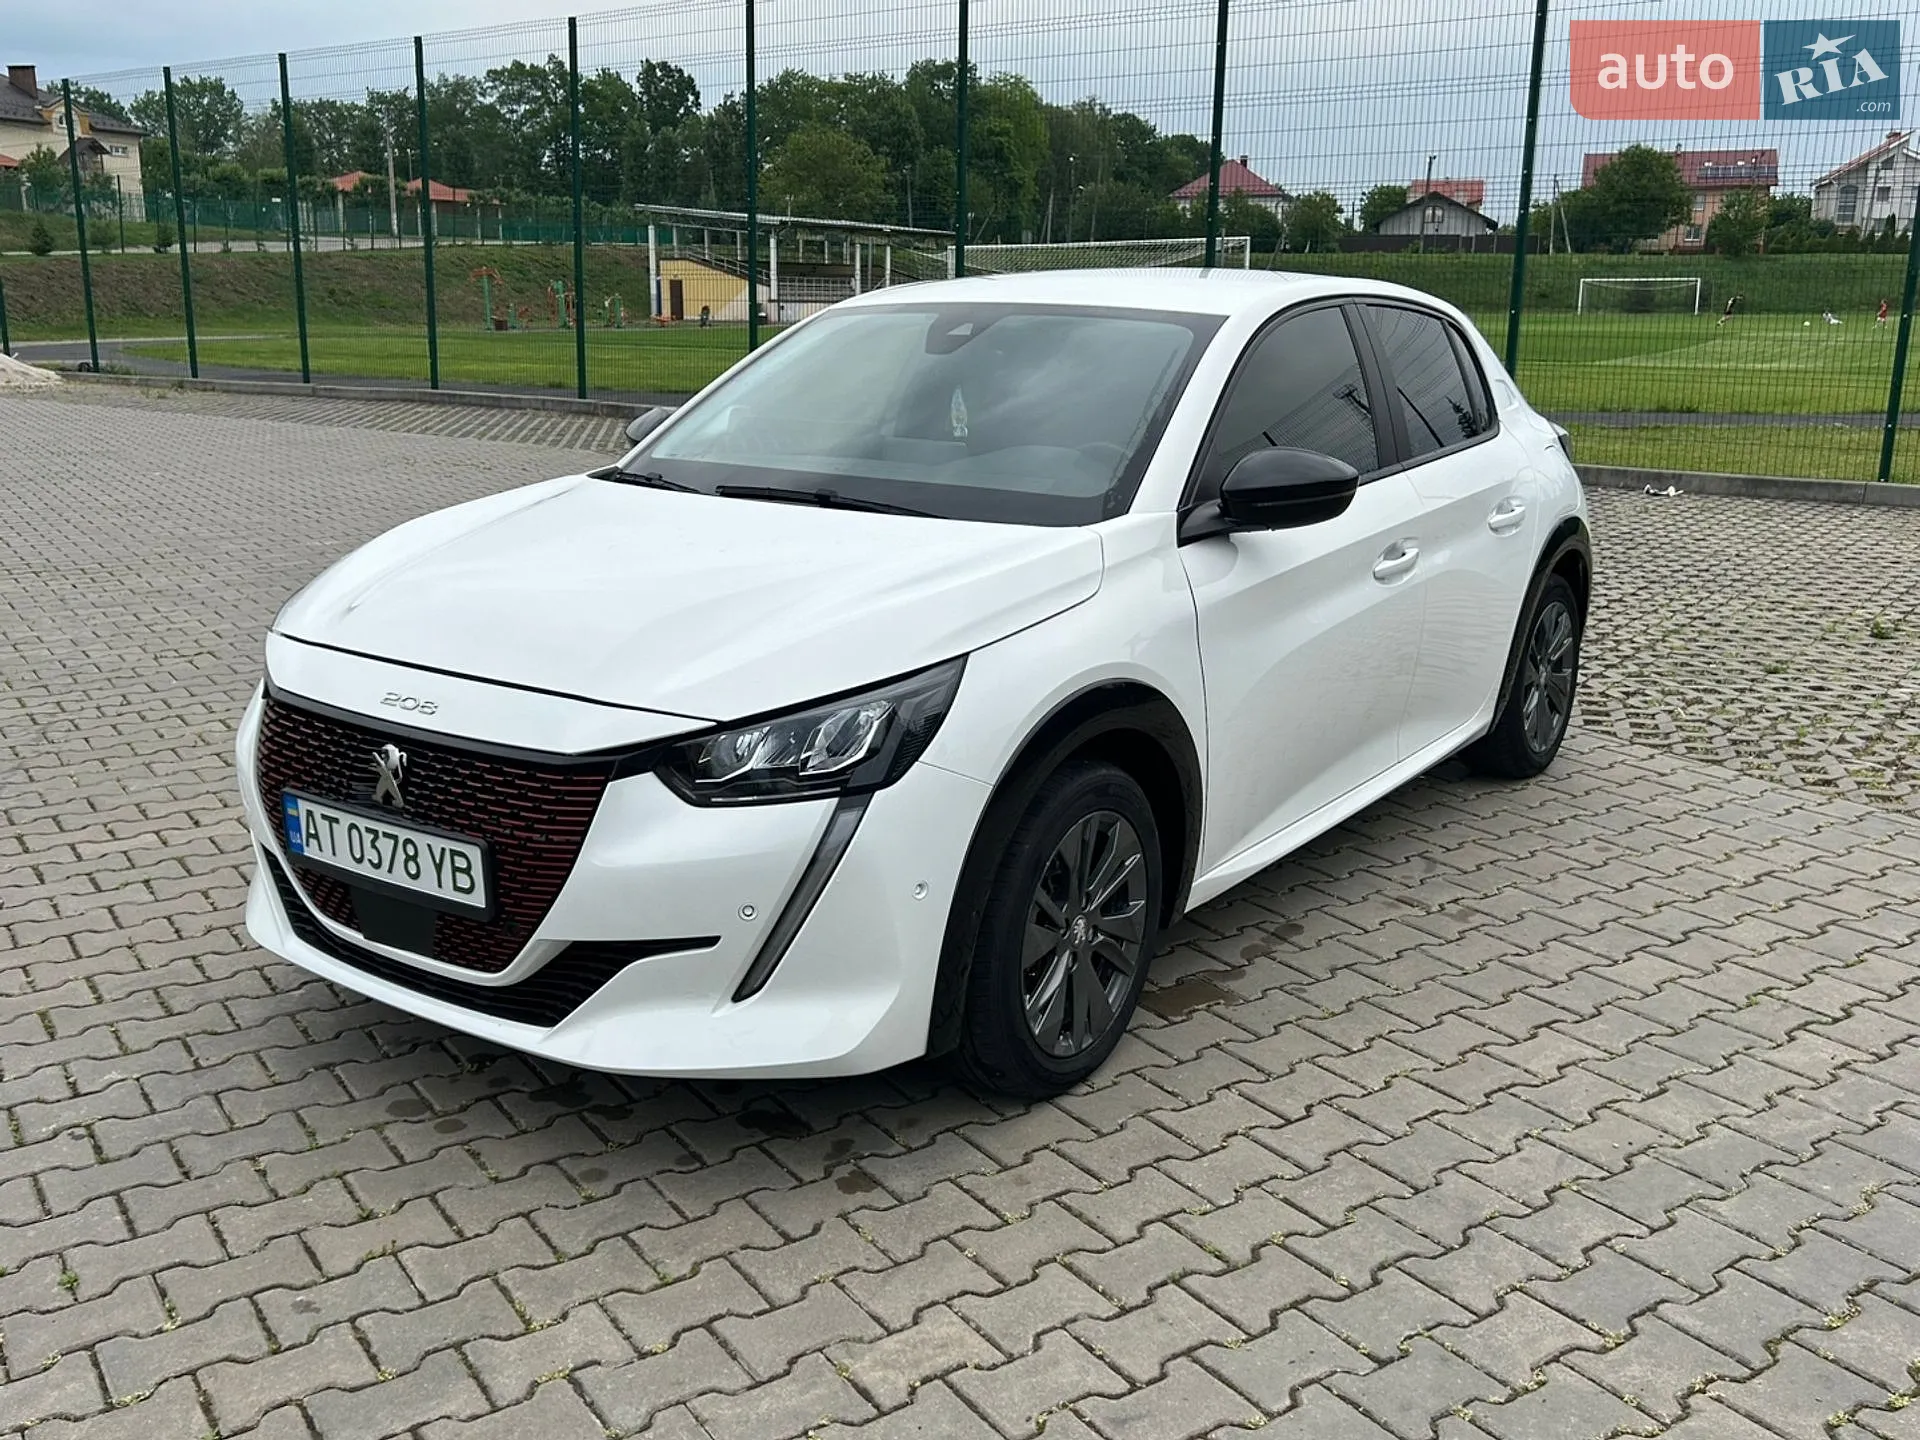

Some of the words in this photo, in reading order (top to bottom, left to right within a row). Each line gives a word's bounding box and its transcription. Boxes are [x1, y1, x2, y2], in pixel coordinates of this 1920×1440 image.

[379, 691, 439, 716] 208
[306, 809, 340, 857] AT
[347, 822, 421, 881] 0378
[427, 842, 476, 895] YB
